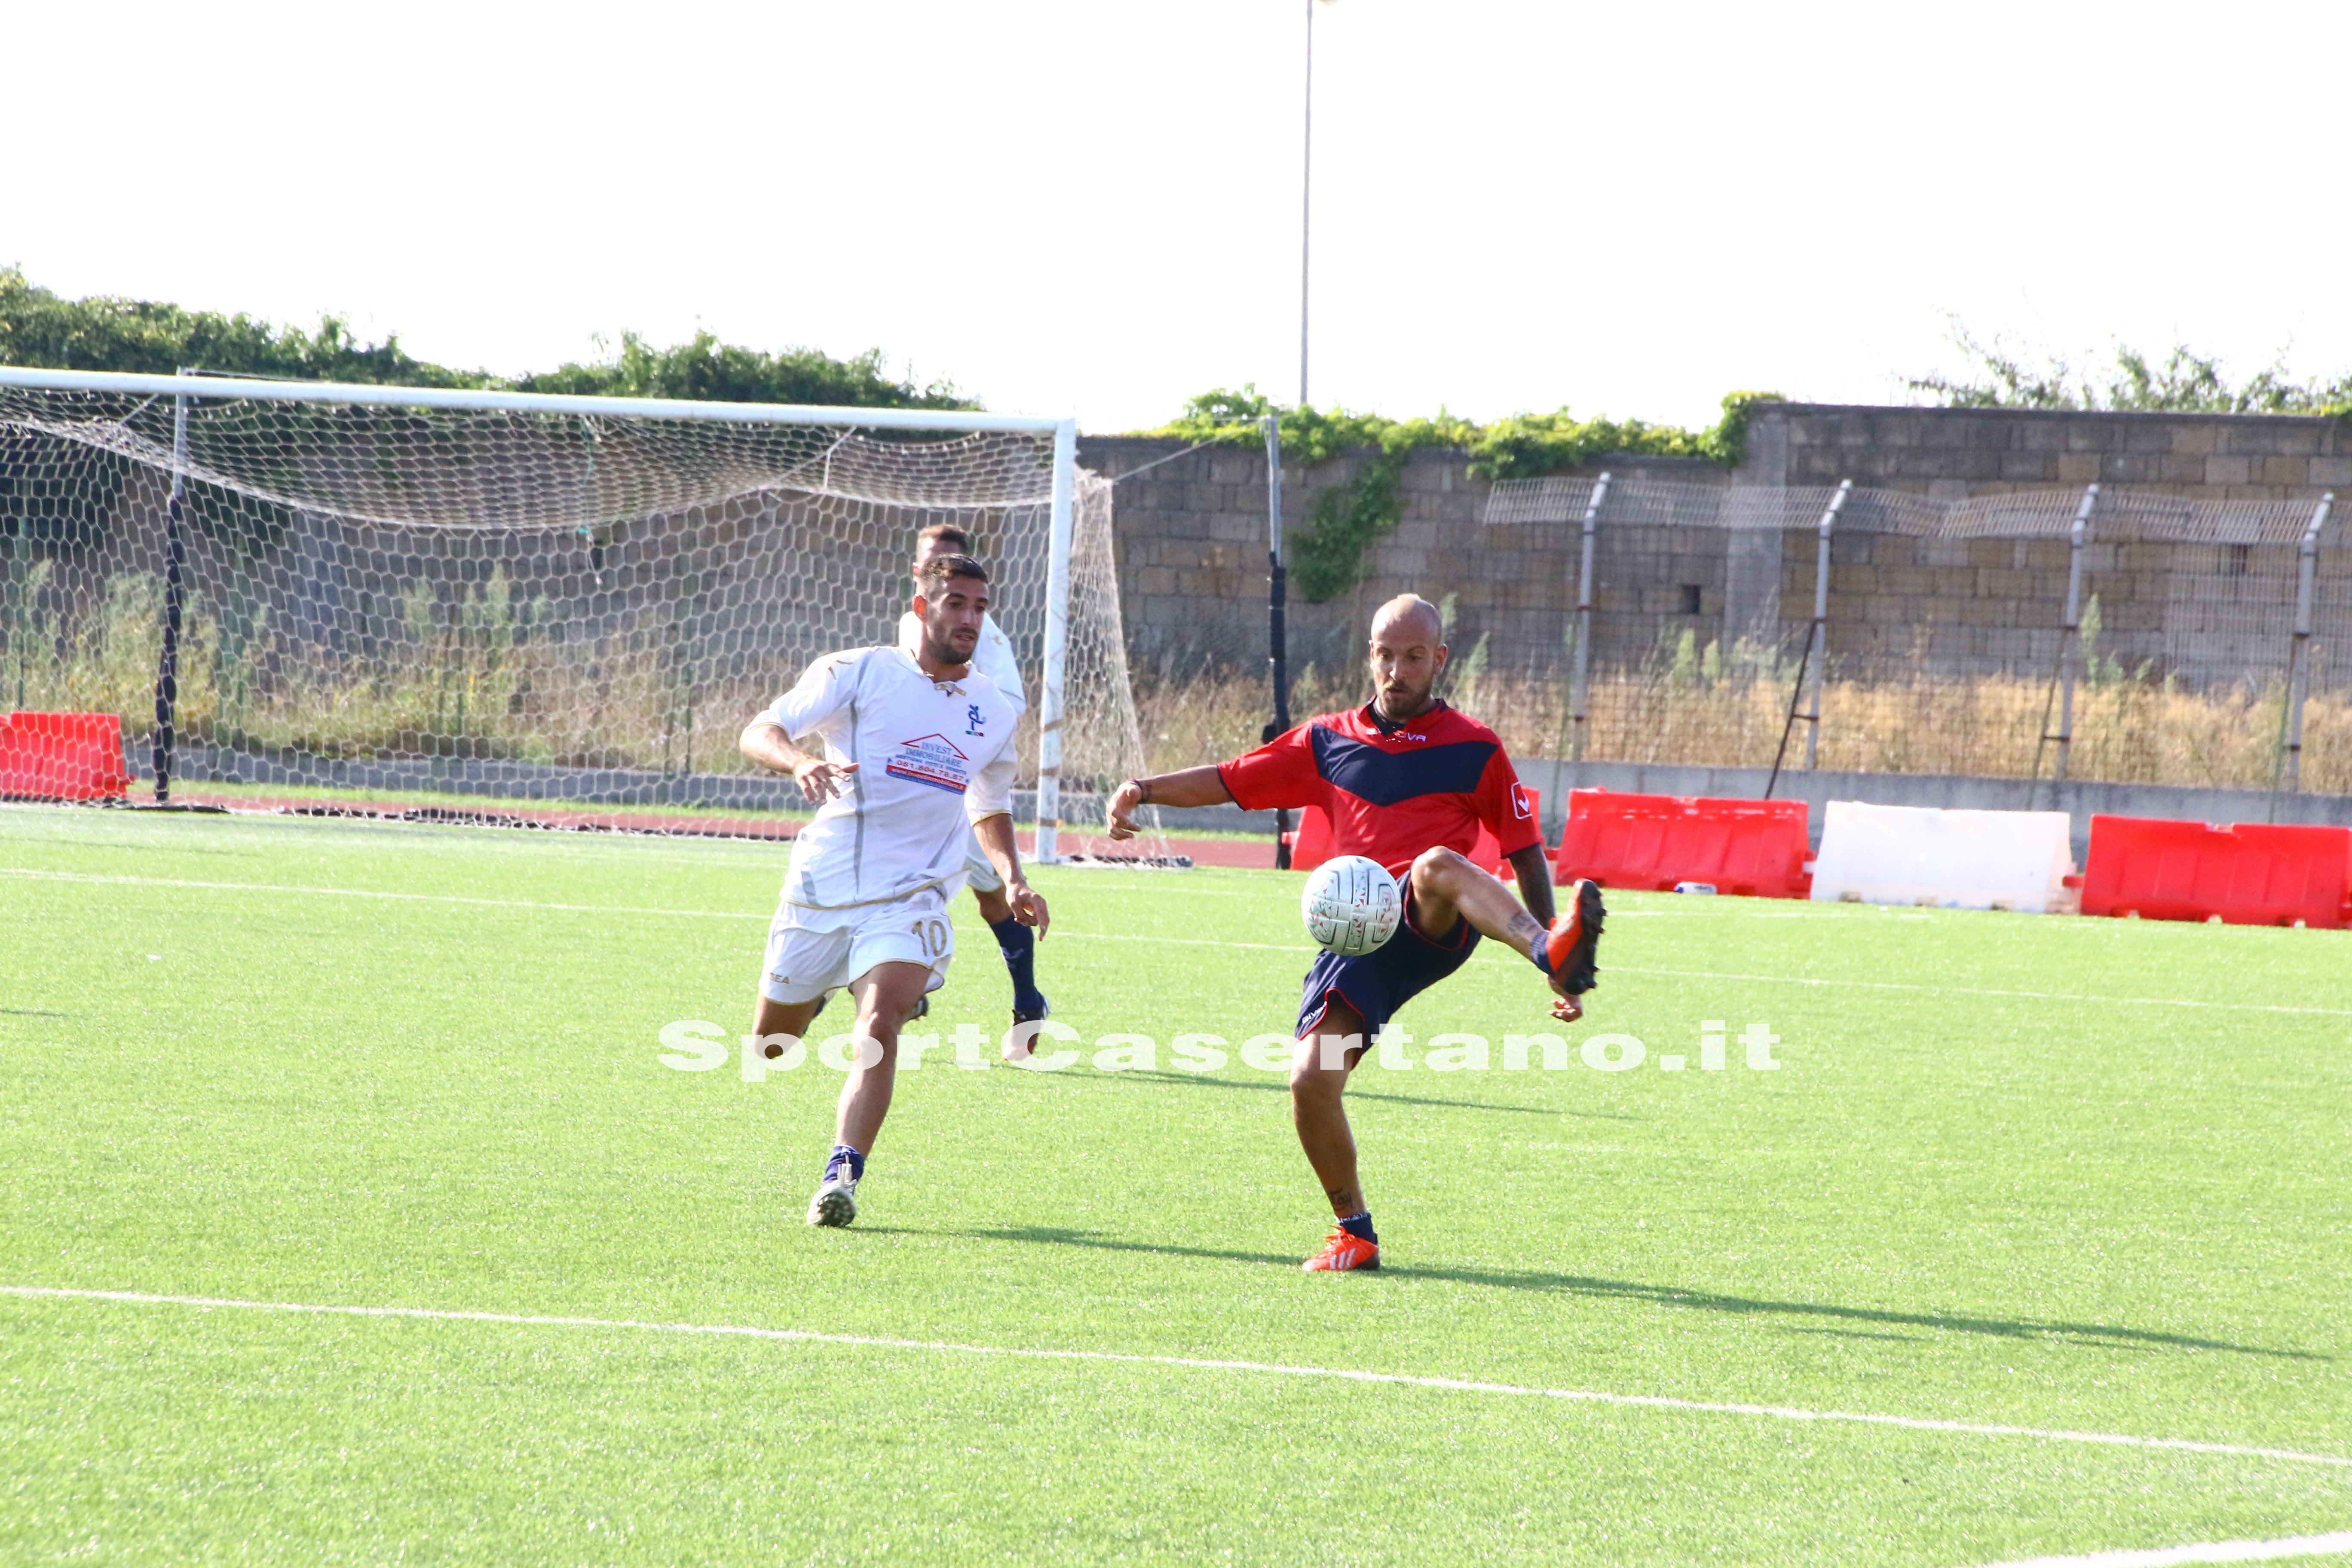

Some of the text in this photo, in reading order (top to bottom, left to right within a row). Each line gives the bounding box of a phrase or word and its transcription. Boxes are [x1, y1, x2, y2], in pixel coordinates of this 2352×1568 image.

[906, 748, 962, 767] IMMOBILIARE
[922, 742, 952, 755] INVEST
[912, 920, 947, 957] 10
